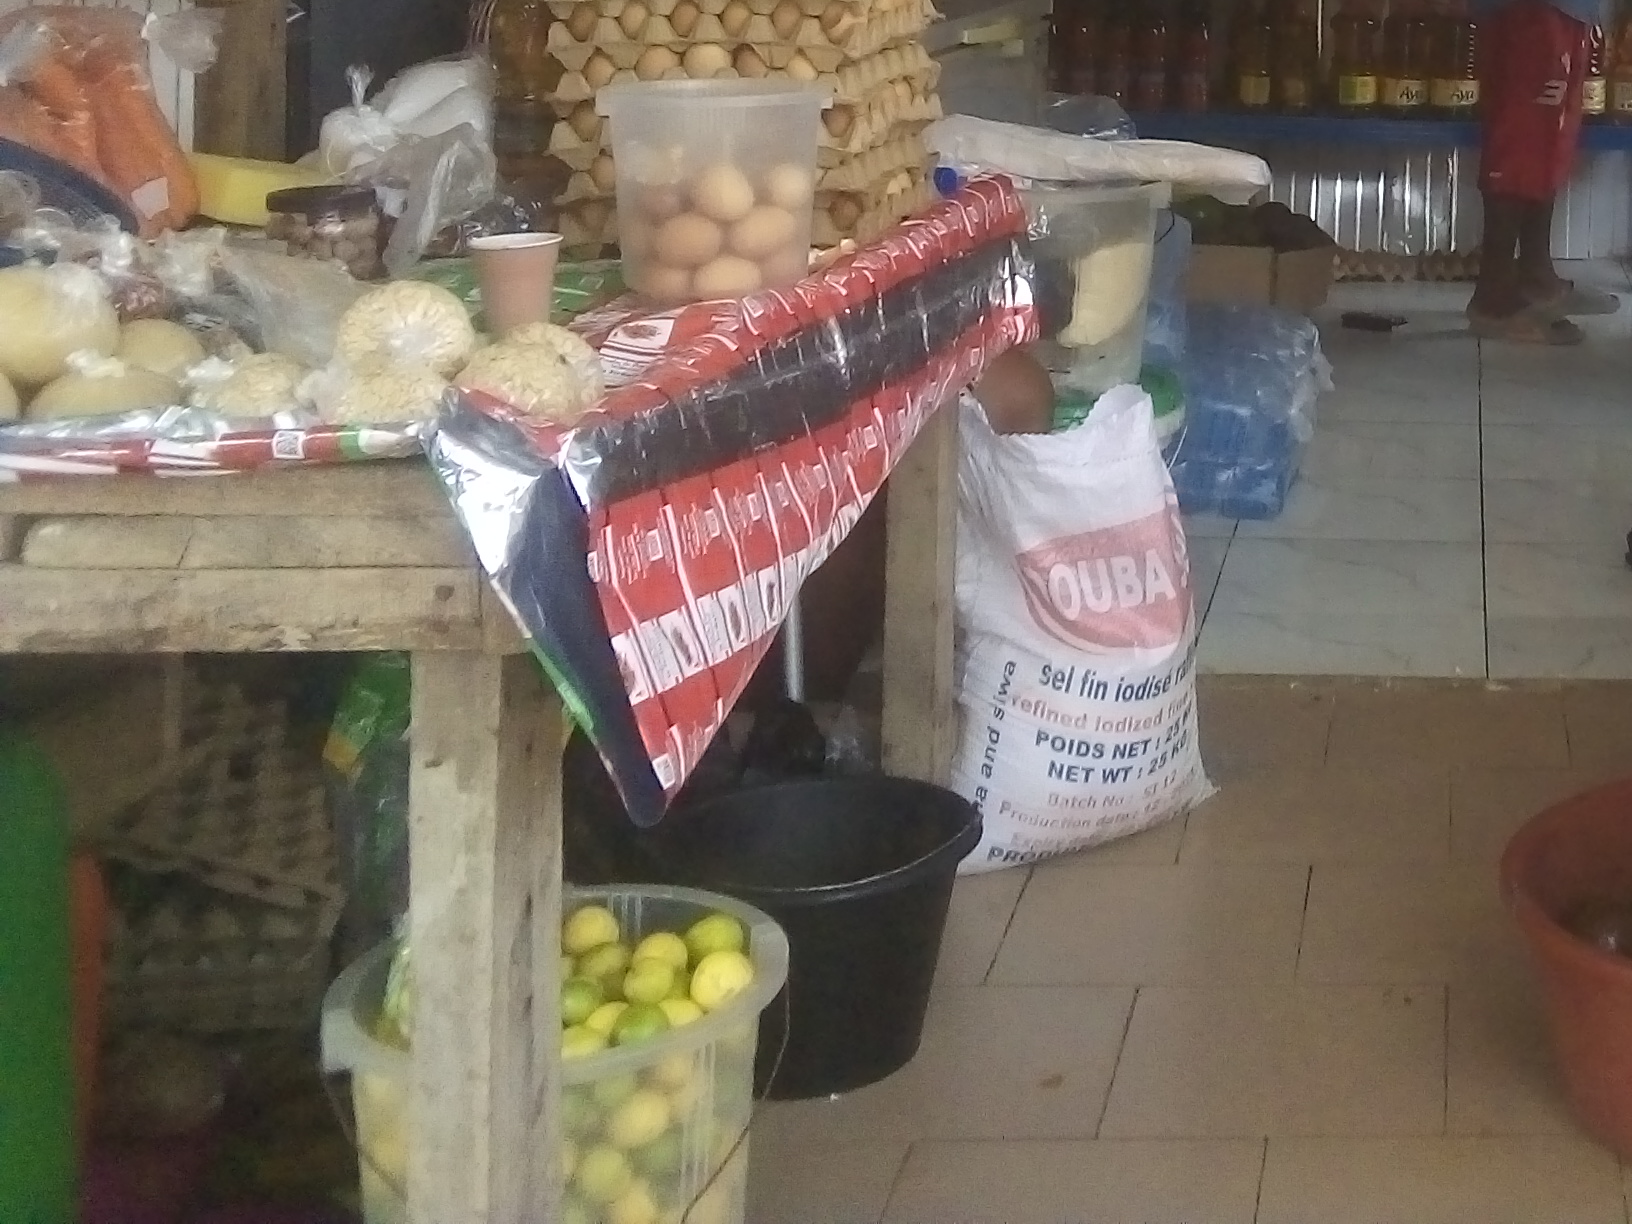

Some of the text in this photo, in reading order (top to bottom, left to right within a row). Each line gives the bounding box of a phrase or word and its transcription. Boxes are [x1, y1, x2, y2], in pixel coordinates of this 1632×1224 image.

[1047, 547, 1177, 621] OUBA
[1038, 659, 1075, 694] sel
[1079, 669, 1109, 702] fin
[1010, 692, 1088, 733] refined
[980, 725, 1001, 780] and
[1034, 728, 1105, 760] POIDS
[1111, 737, 1153, 761] NET
[1047, 759, 1096, 784] NET
[1101, 764, 1134, 785] WT
